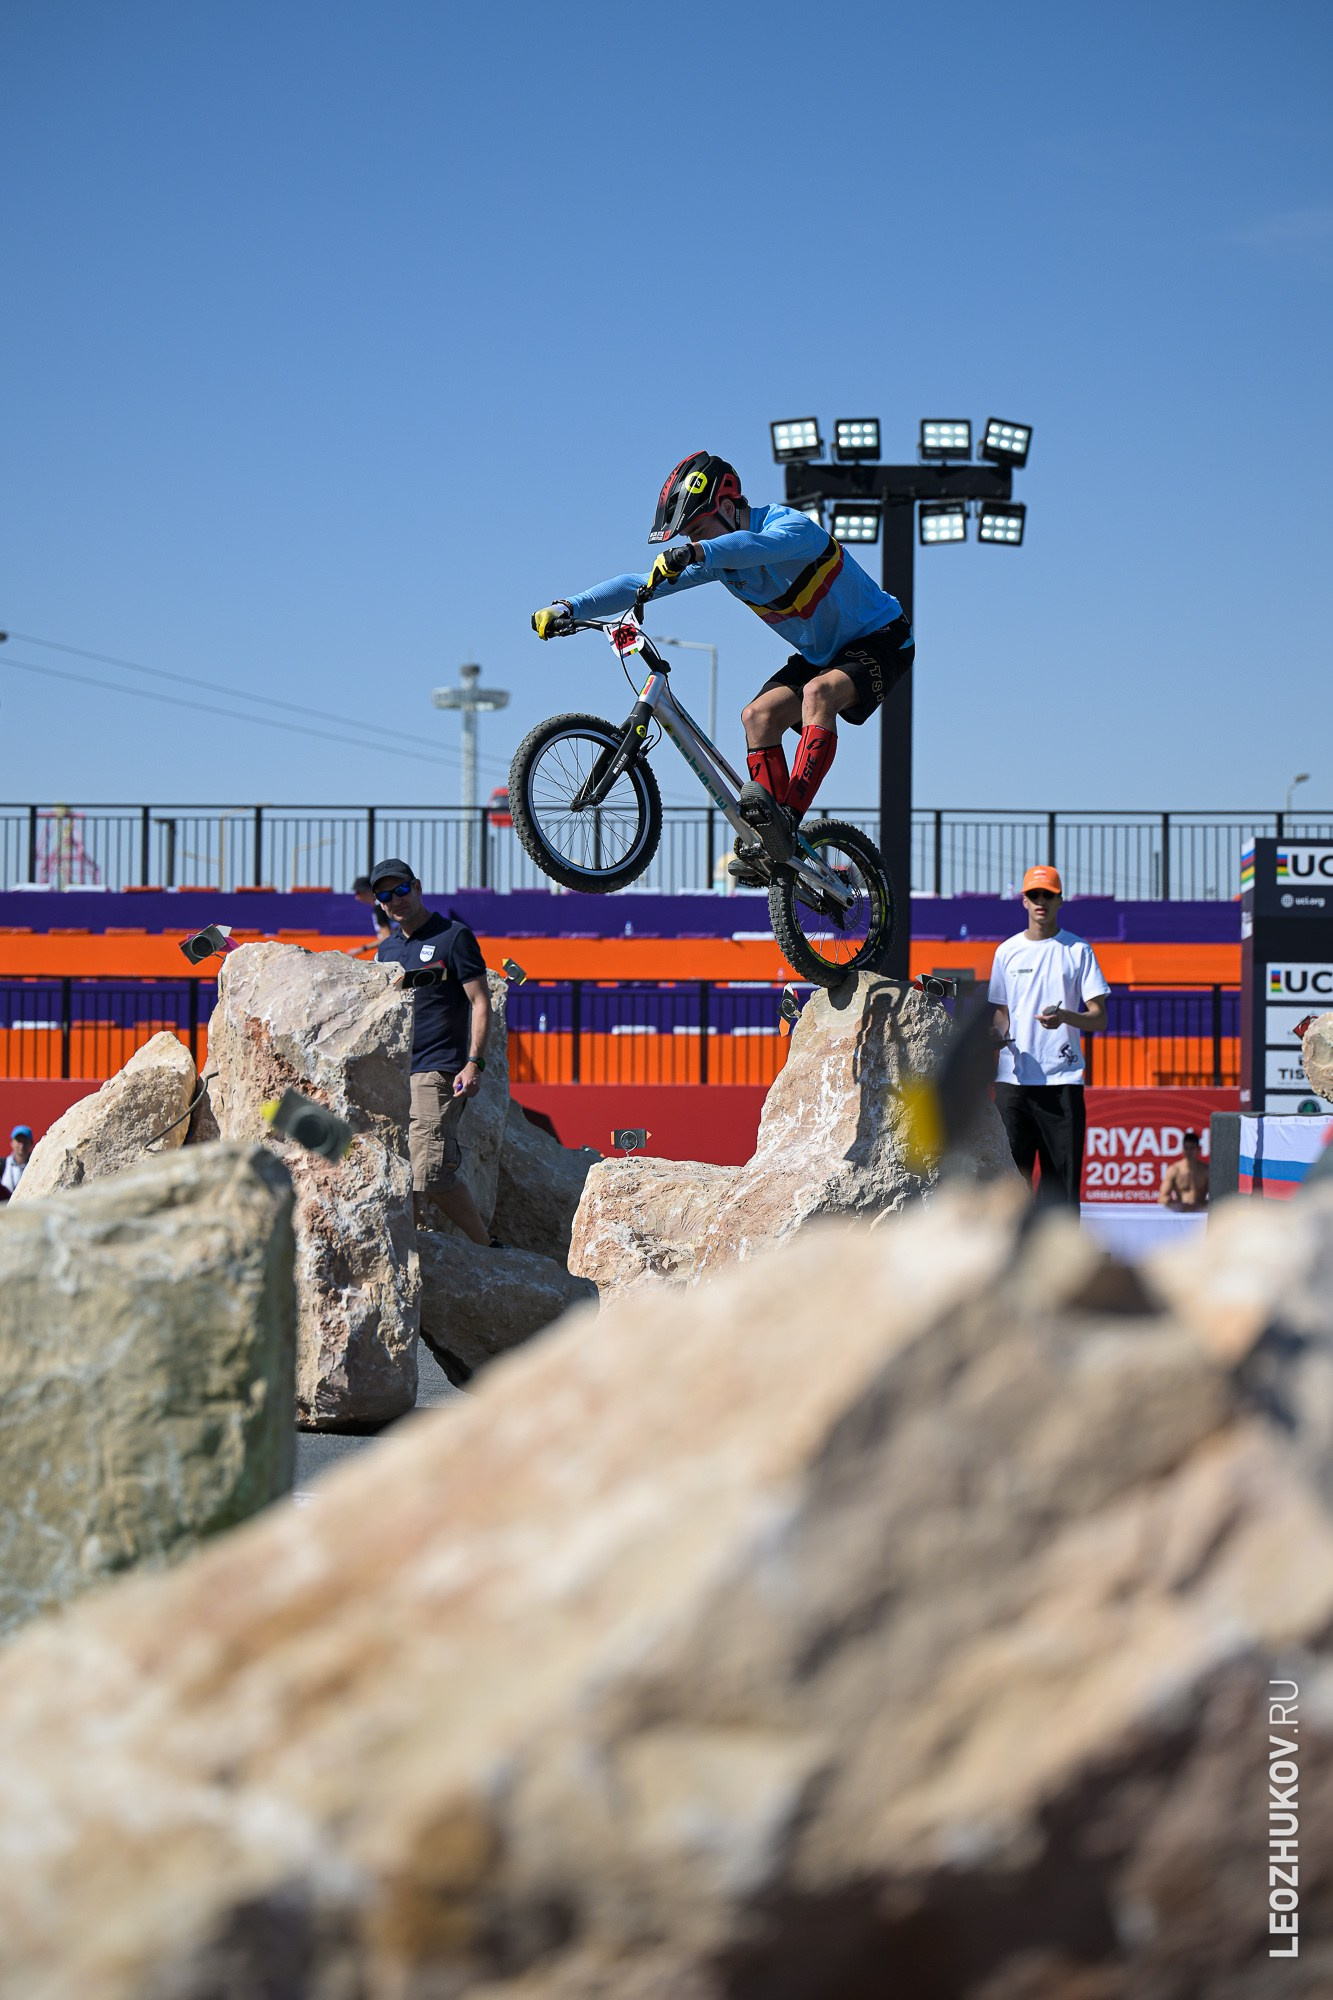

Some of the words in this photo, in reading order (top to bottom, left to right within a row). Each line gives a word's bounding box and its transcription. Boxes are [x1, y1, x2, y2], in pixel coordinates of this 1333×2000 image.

[1085, 1161, 1155, 1186] 2025
[1086, 1190, 1123, 1201] URBAN
[1124, 1190, 1161, 1201] CYCLIN
